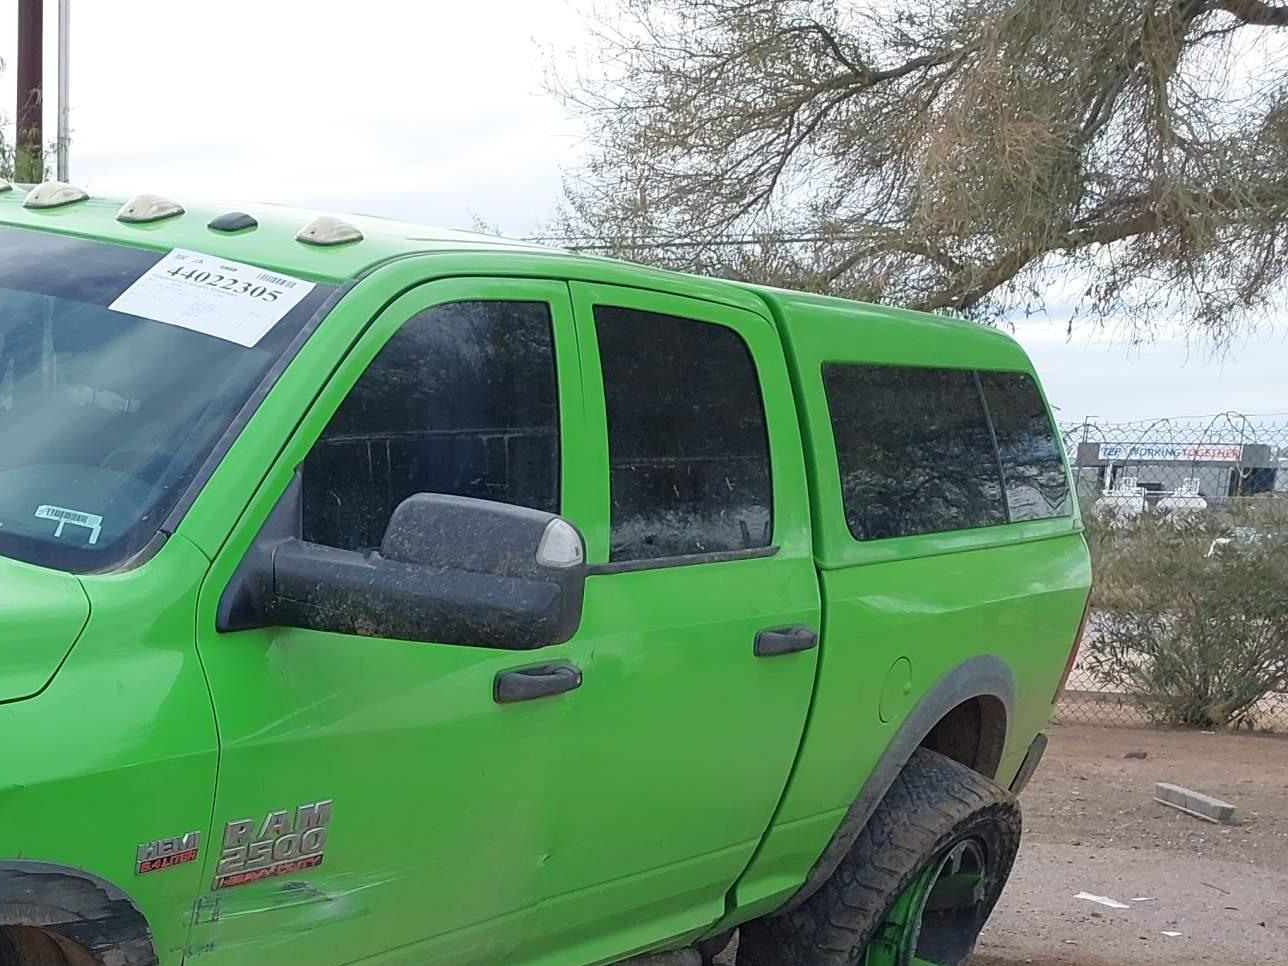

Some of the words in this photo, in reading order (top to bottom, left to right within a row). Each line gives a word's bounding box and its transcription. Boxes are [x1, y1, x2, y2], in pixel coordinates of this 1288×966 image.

[167, 265, 283, 303] 44022305
[1102, 447, 1122, 456] TEP
[220, 799, 333, 849] RAM
[137, 830, 201, 862] HEMI
[217, 827, 327, 875] 2500
